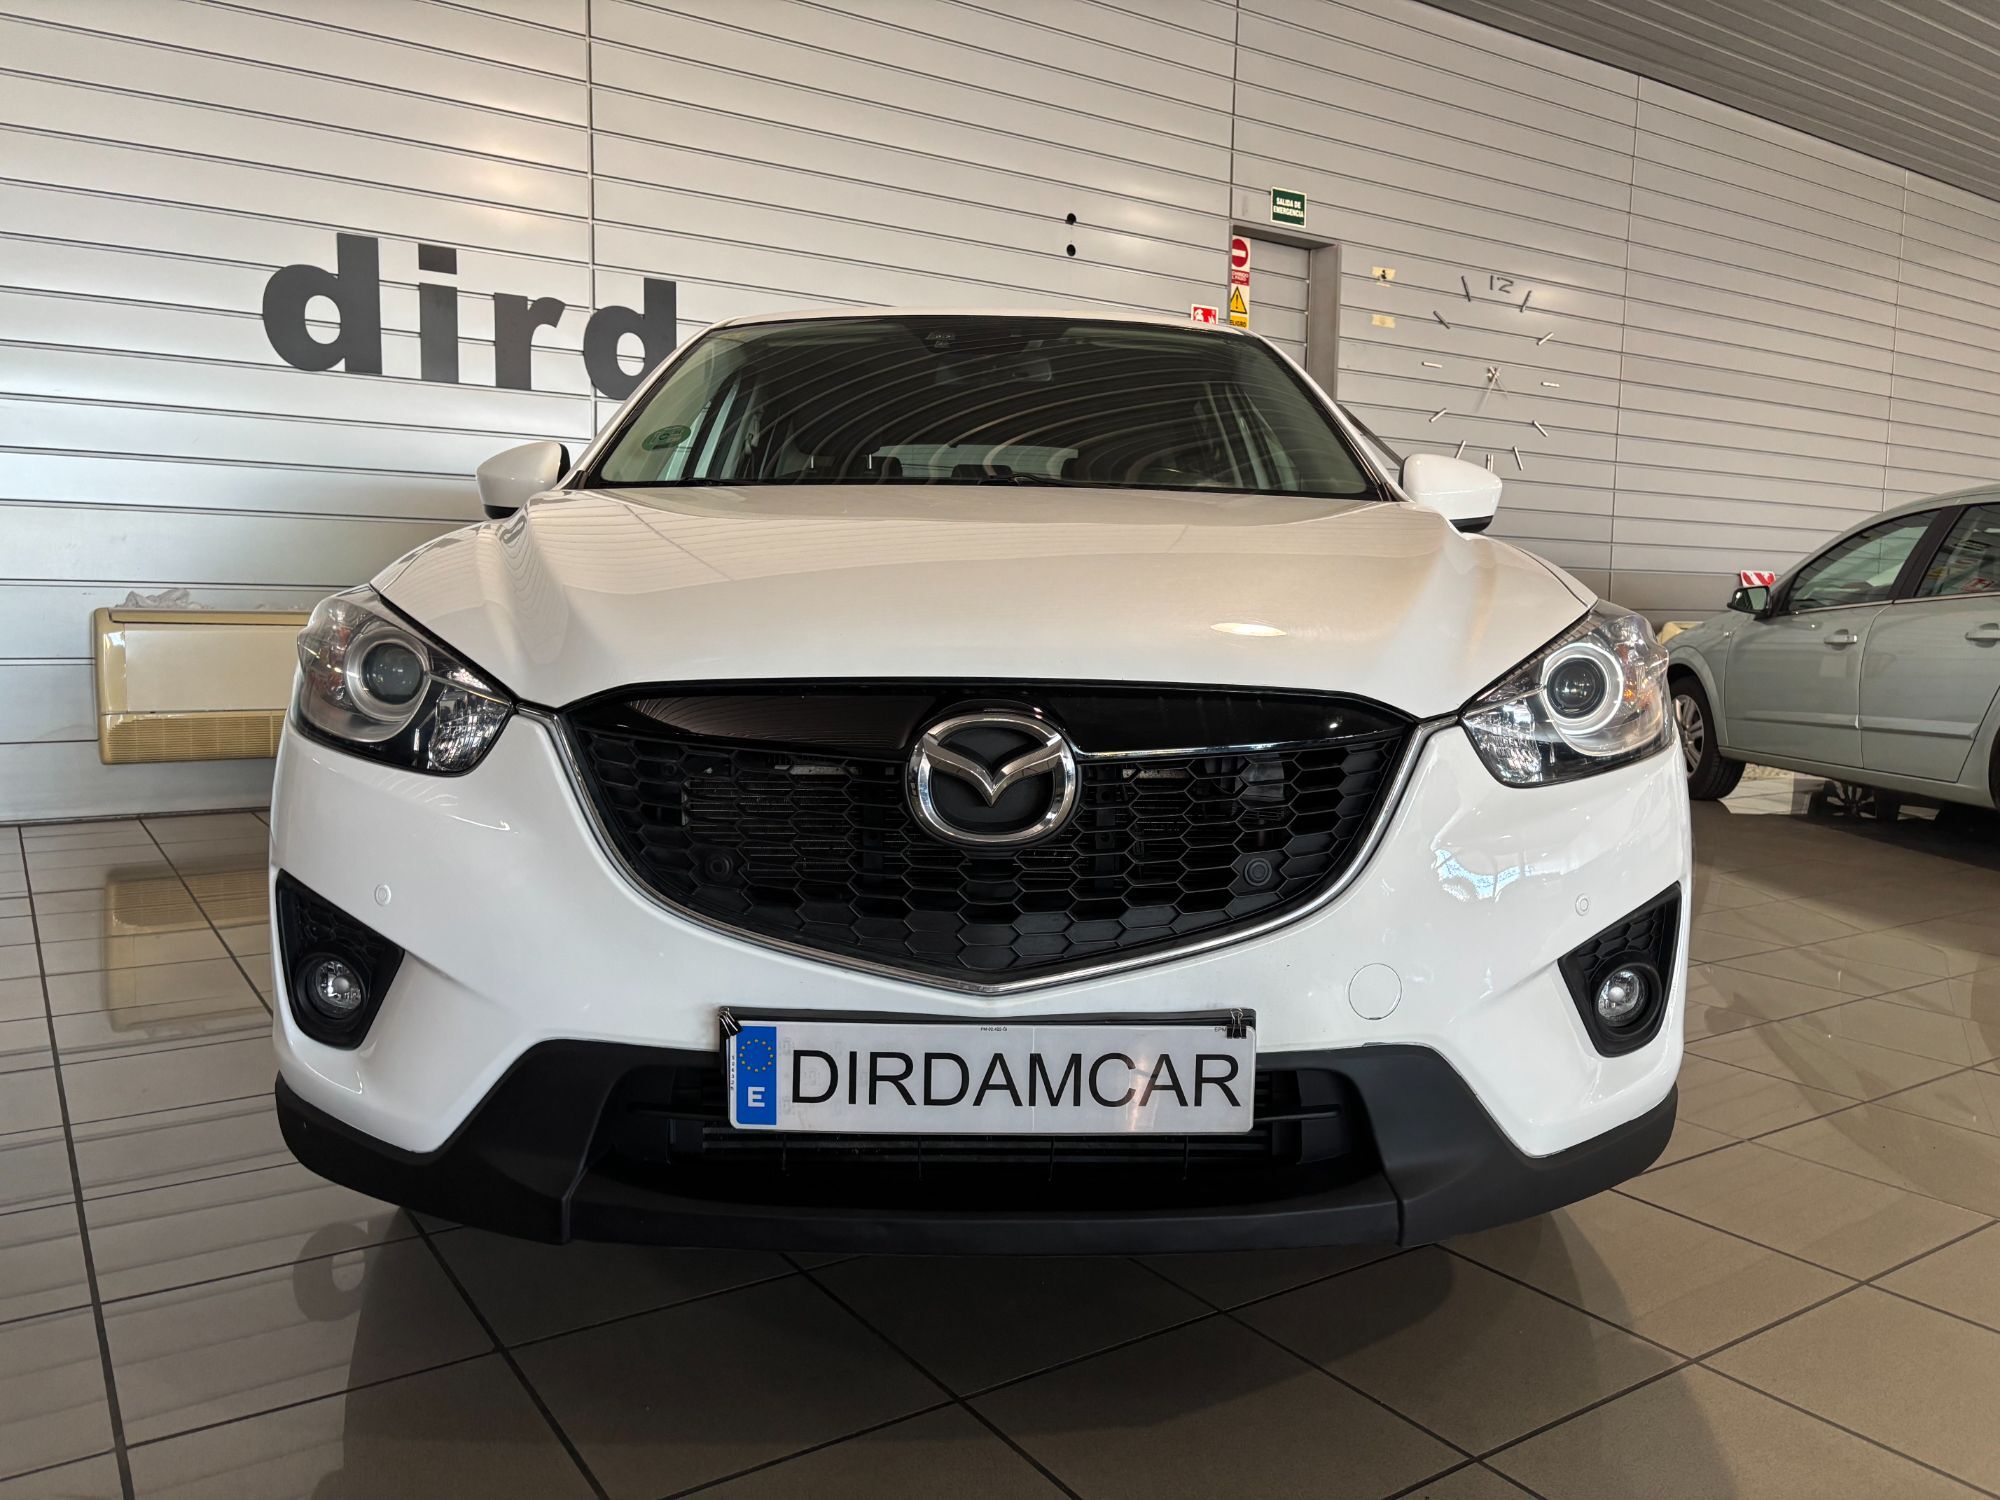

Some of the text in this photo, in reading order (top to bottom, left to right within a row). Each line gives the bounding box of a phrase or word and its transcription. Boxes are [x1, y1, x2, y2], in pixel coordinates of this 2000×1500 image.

[1273, 205, 1304, 218] EMERGENCIA
[1276, 197, 1302, 209] SALIDA DE
[1489, 275, 1514, 293] 12
[262, 232, 677, 401] dird
[747, 1048, 1242, 1108] E DIRDAMCAR
